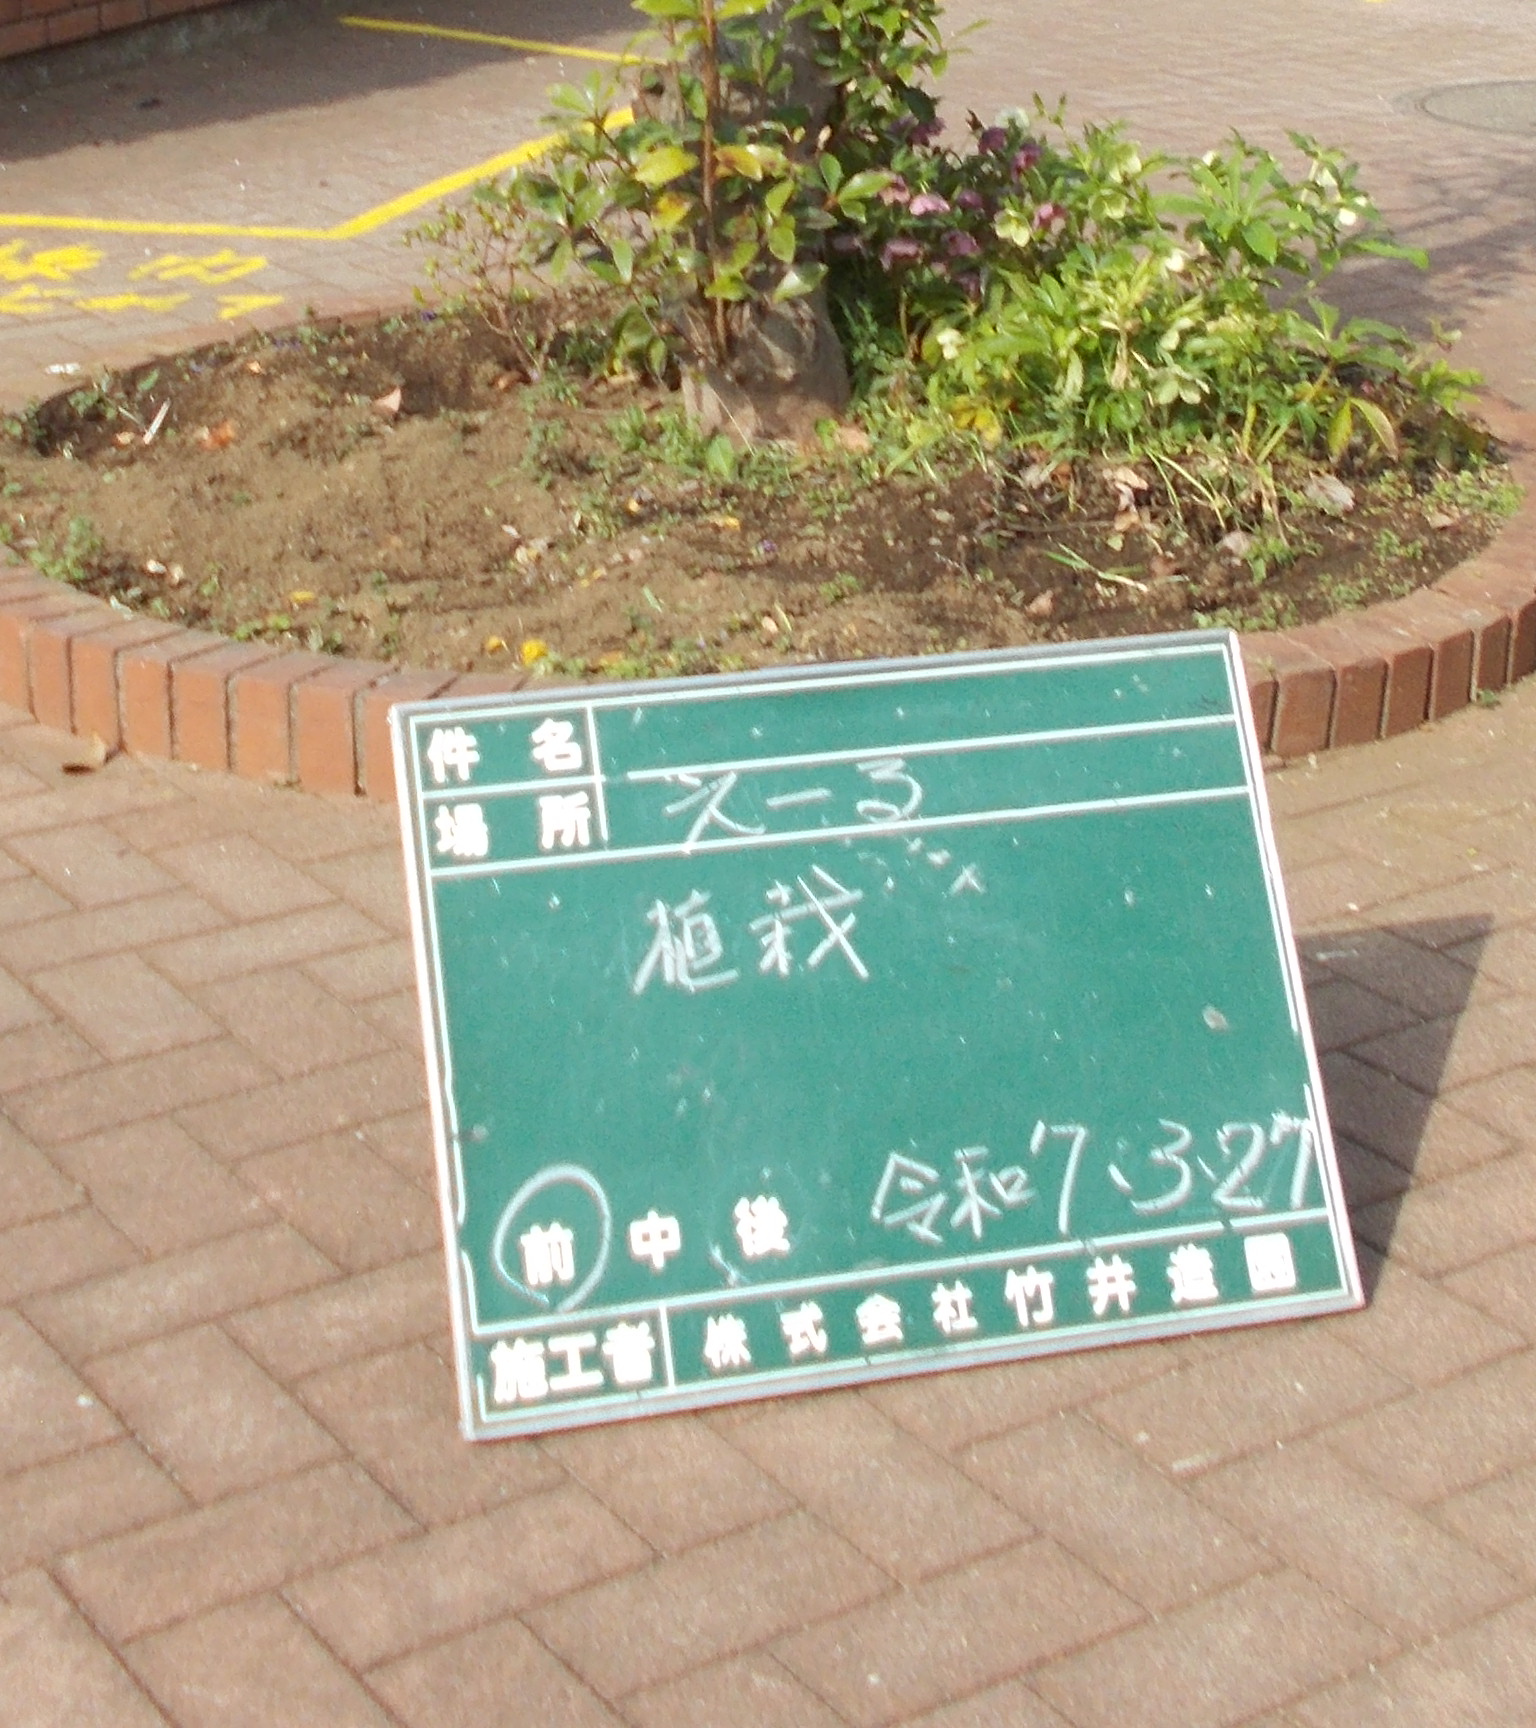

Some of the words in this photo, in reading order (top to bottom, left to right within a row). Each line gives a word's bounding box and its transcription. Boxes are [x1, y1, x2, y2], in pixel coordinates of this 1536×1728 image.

[427, 717, 583, 784] 件名
[435, 791, 592, 858] 場所
[632, 864, 869, 997] 植栽
[490, 1331, 658, 1404] 施工者
